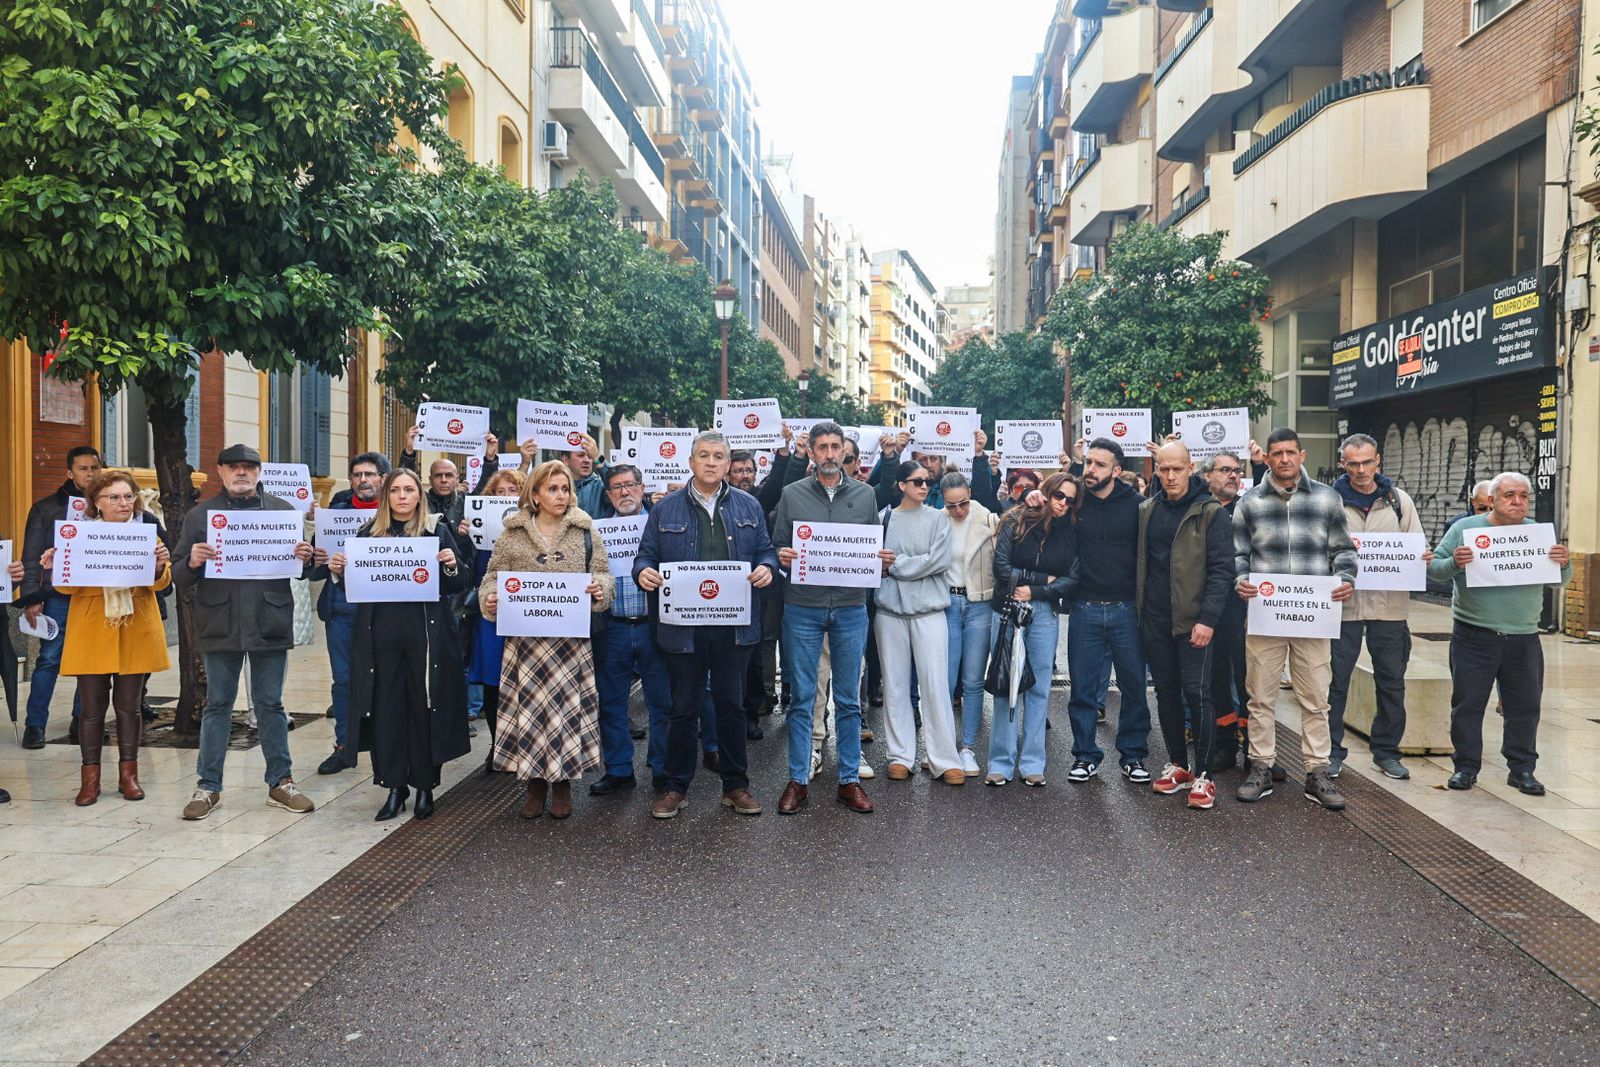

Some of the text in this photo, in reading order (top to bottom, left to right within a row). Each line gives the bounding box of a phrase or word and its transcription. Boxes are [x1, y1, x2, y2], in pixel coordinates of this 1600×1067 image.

[1494, 277, 1537, 300] Centro Oficia
[1495, 295, 1537, 315] COMPRO ORO
[525, 417, 578, 427] SINIESTRALIDAD
[536, 429, 566, 437] LABORAL
[1539, 439, 1556, 457] BUY
[1538, 457, 1556, 476] AND
[472, 500, 483, 544] UGT
[241, 523, 259, 531] MÁS
[598, 526, 618, 534] STOP
[100, 533, 115, 541] MÁS
[1508, 534, 1529, 543] MÁS
[402, 545, 413, 553] LA
[226, 553, 296, 562] MÁS PREVENCIÓN
[1480, 551, 1521, 559] MUERTES
[62, 542, 71, 583] INFORMA
[799, 543, 807, 582] INFORMA
[1493, 562, 1533, 571] TRABAJO
[829, 566, 875, 574] PREVENCIÓN
[701, 582, 717, 591] UGT
[1293, 585, 1314, 594] MÁS
[663, 570, 671, 613] UGT
[508, 595, 579, 603] SINIESTRALIDAD
[1263, 599, 1304, 608] MUERTES
[1306, 601, 1318, 609] EN
[1275, 613, 1315, 622] TRABAJO
